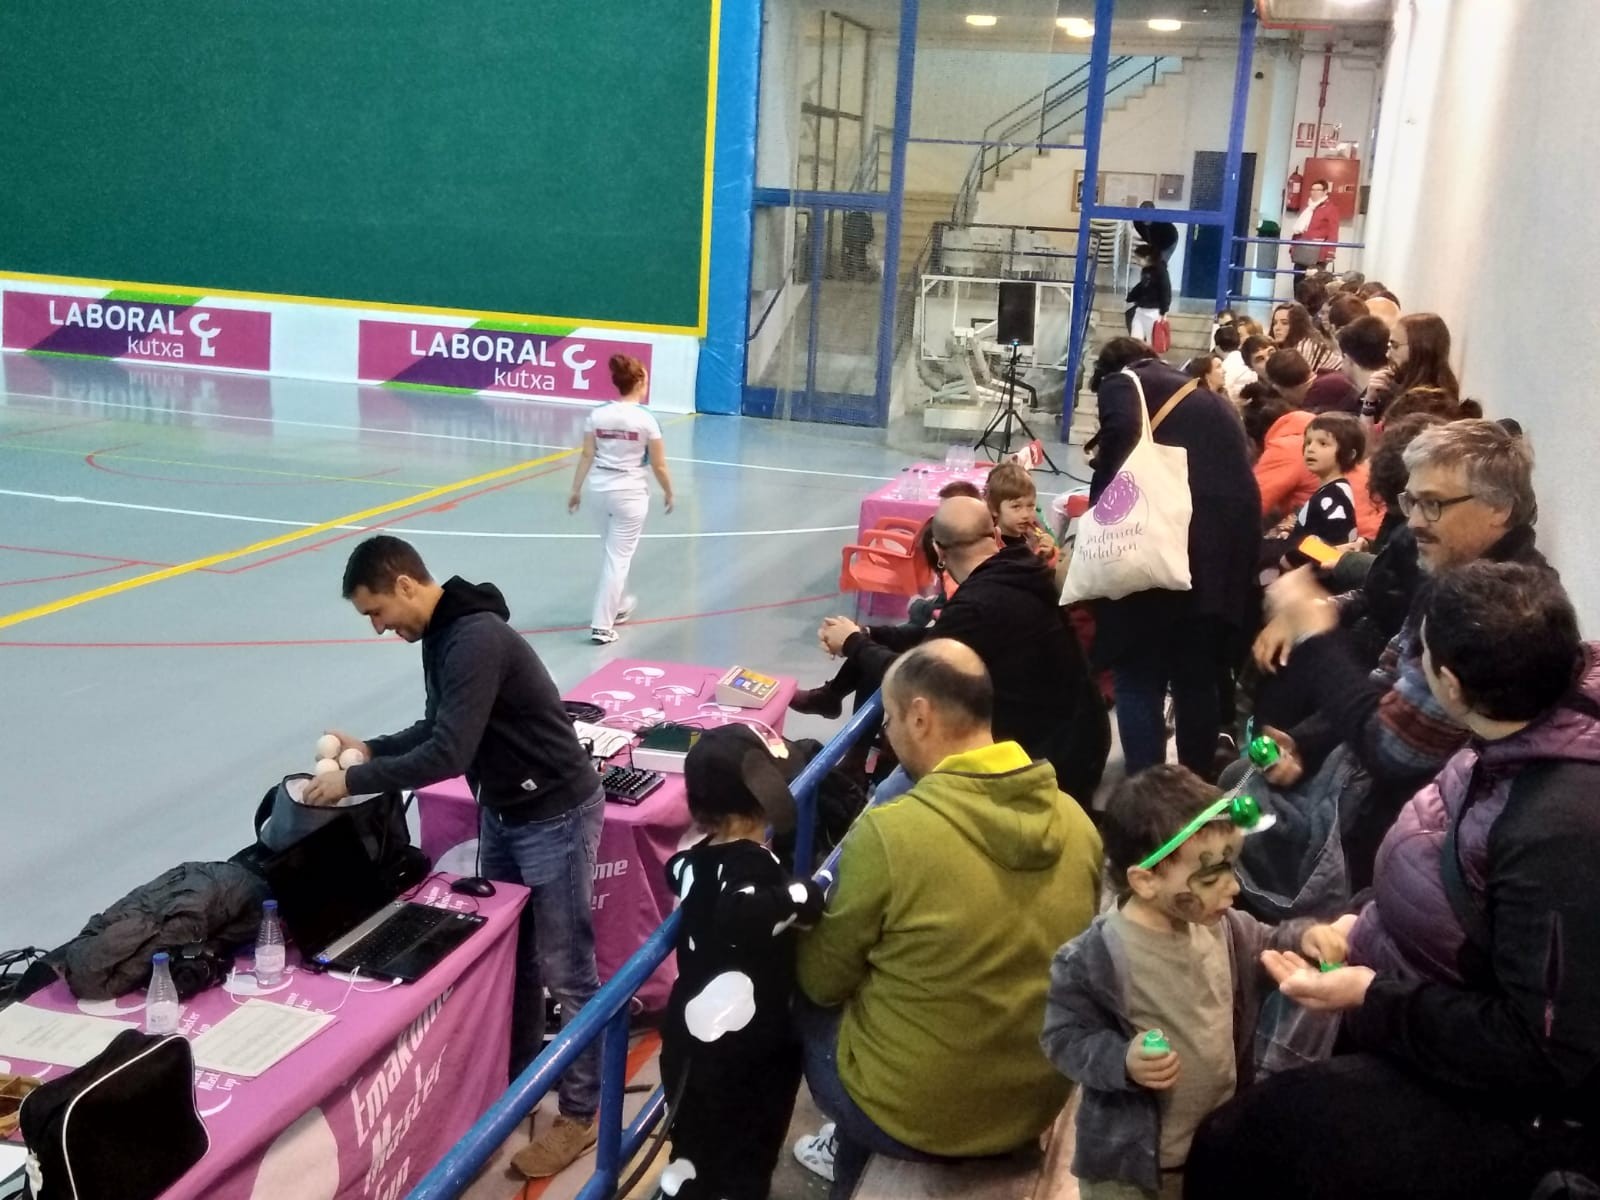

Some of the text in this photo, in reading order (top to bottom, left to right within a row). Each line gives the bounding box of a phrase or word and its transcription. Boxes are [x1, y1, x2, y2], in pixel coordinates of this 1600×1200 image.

[49, 299, 184, 335] LABORAL
[127, 336, 184, 358] kutxa
[410, 329, 556, 367] LABORAL
[494, 368, 555, 391] kutxa
[363, 1043, 447, 1196] Master
